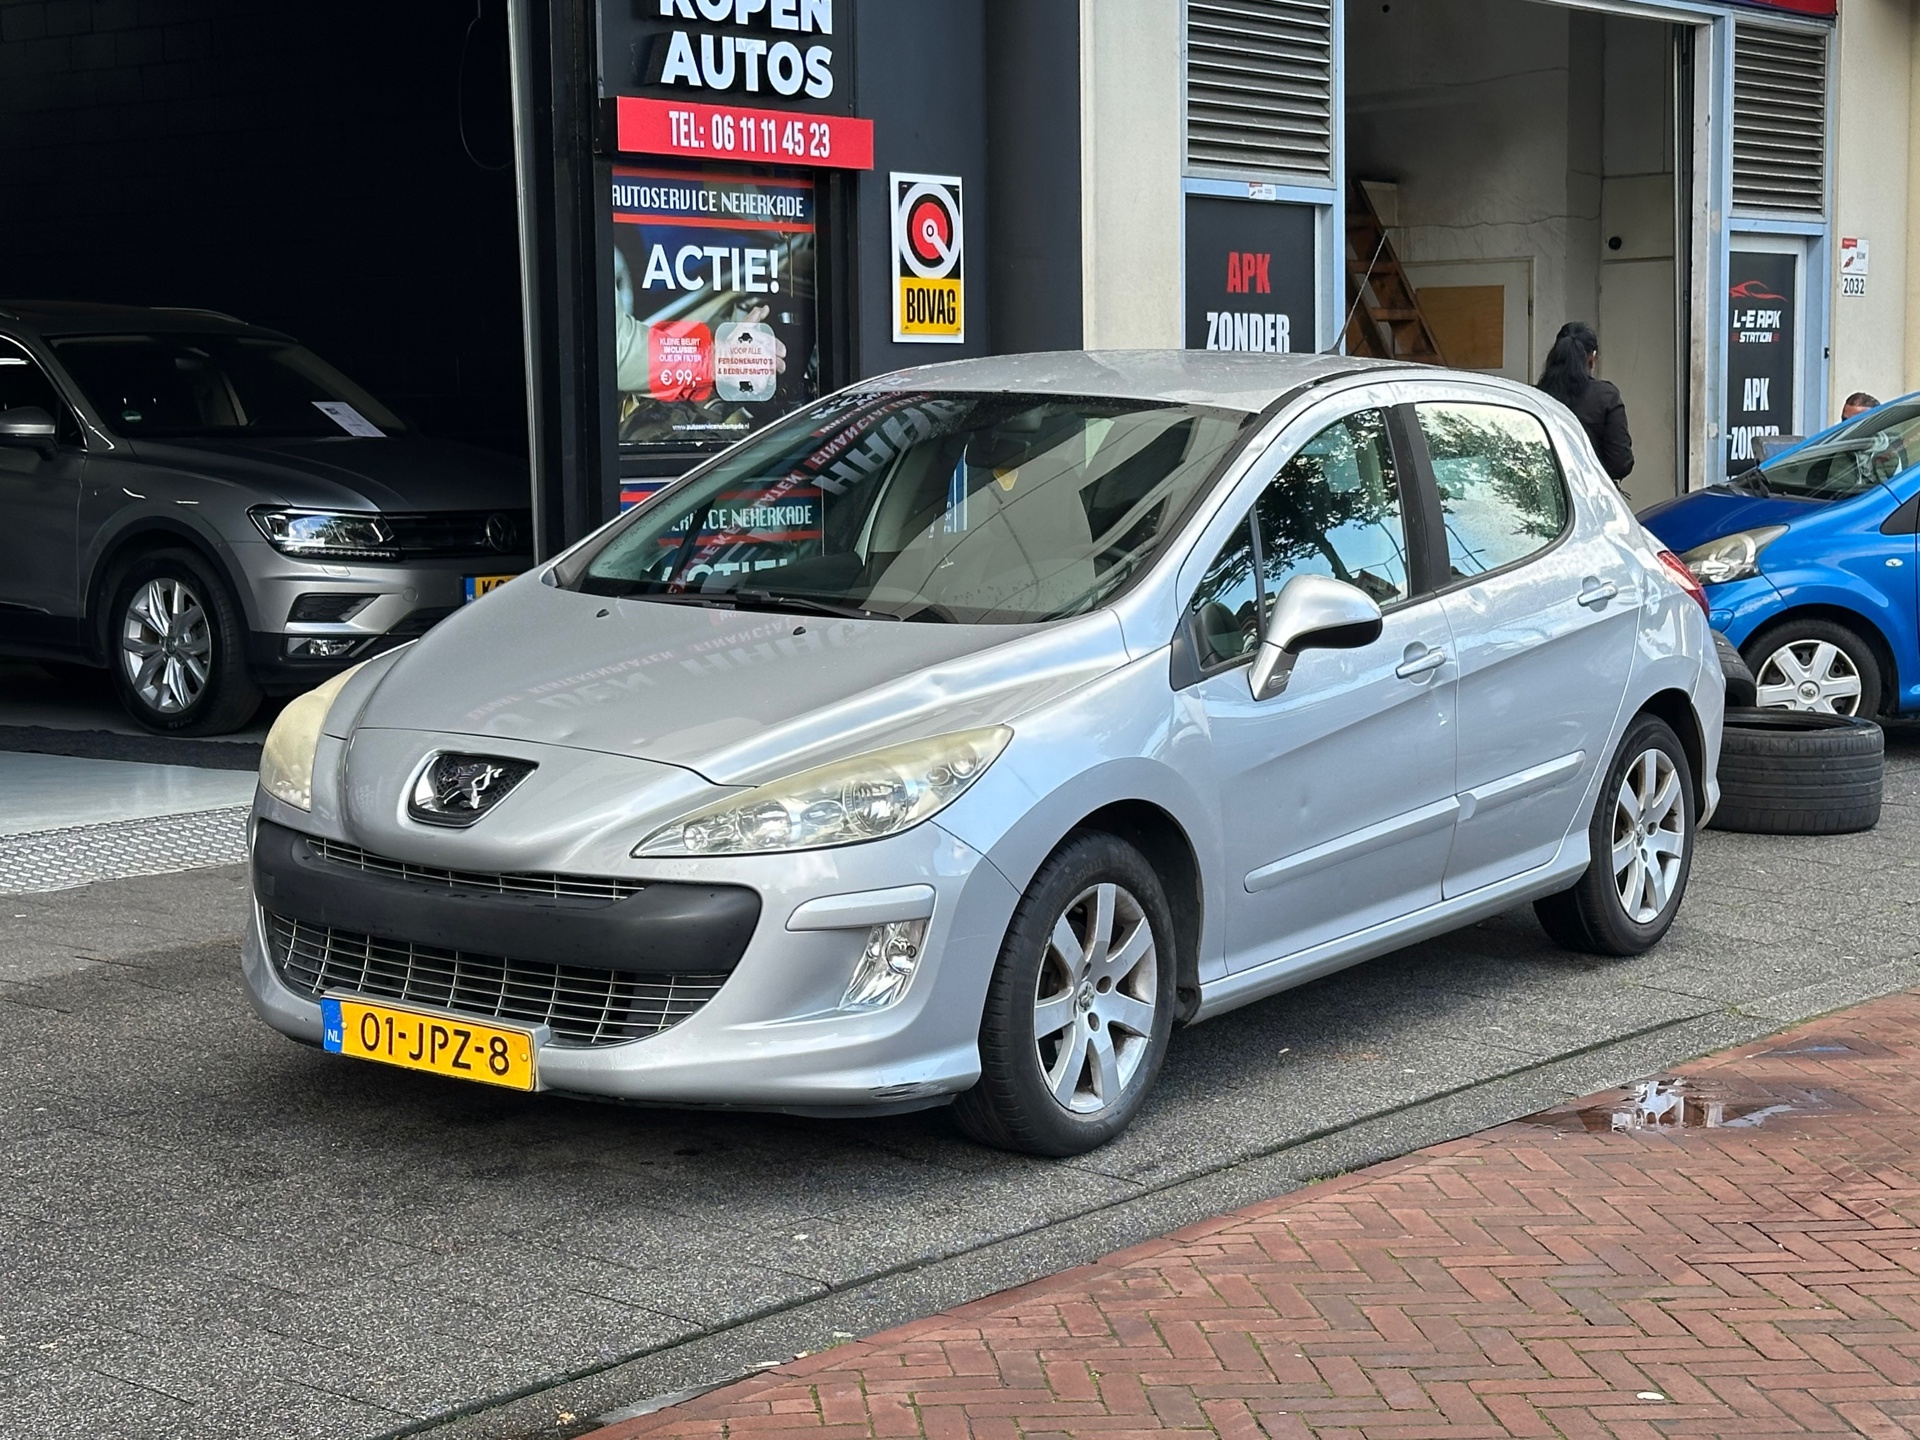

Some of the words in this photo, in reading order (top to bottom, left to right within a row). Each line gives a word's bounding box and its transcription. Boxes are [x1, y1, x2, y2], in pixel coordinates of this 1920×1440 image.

[660, 0, 832, 34] PEN
[660, 31, 834, 99] AUTOS
[669, 111, 705, 148] TEL:
[711, 114, 735, 151] 06
[740, 117, 756, 152] 11
[761, 119, 777, 154] 11
[782, 121, 804, 156] 45
[809, 123, 830, 158] 23
[612, 184, 717, 212] AUTOSERVICE
[721, 191, 804, 217] NEHERKADE
[641, 243, 780, 294] ACTIE!
[1226, 251, 1271, 293] APK
[1843, 277, 1865, 294] 2032
[906, 287, 956, 325] BOVAG
[1733, 309, 1756, 328] L-E
[1756, 310, 1781, 329] APK
[1206, 311, 1290, 353] ZONDER
[1739, 331, 1773, 343] STATION
[675, 369, 702, 388] 99,-
[1743, 377, 1770, 411] APK
[731, 505, 813, 527] NEHERKADE
[327, 1028, 341, 1043] NL
[360, 1012, 510, 1076] 01-JPZ-8
